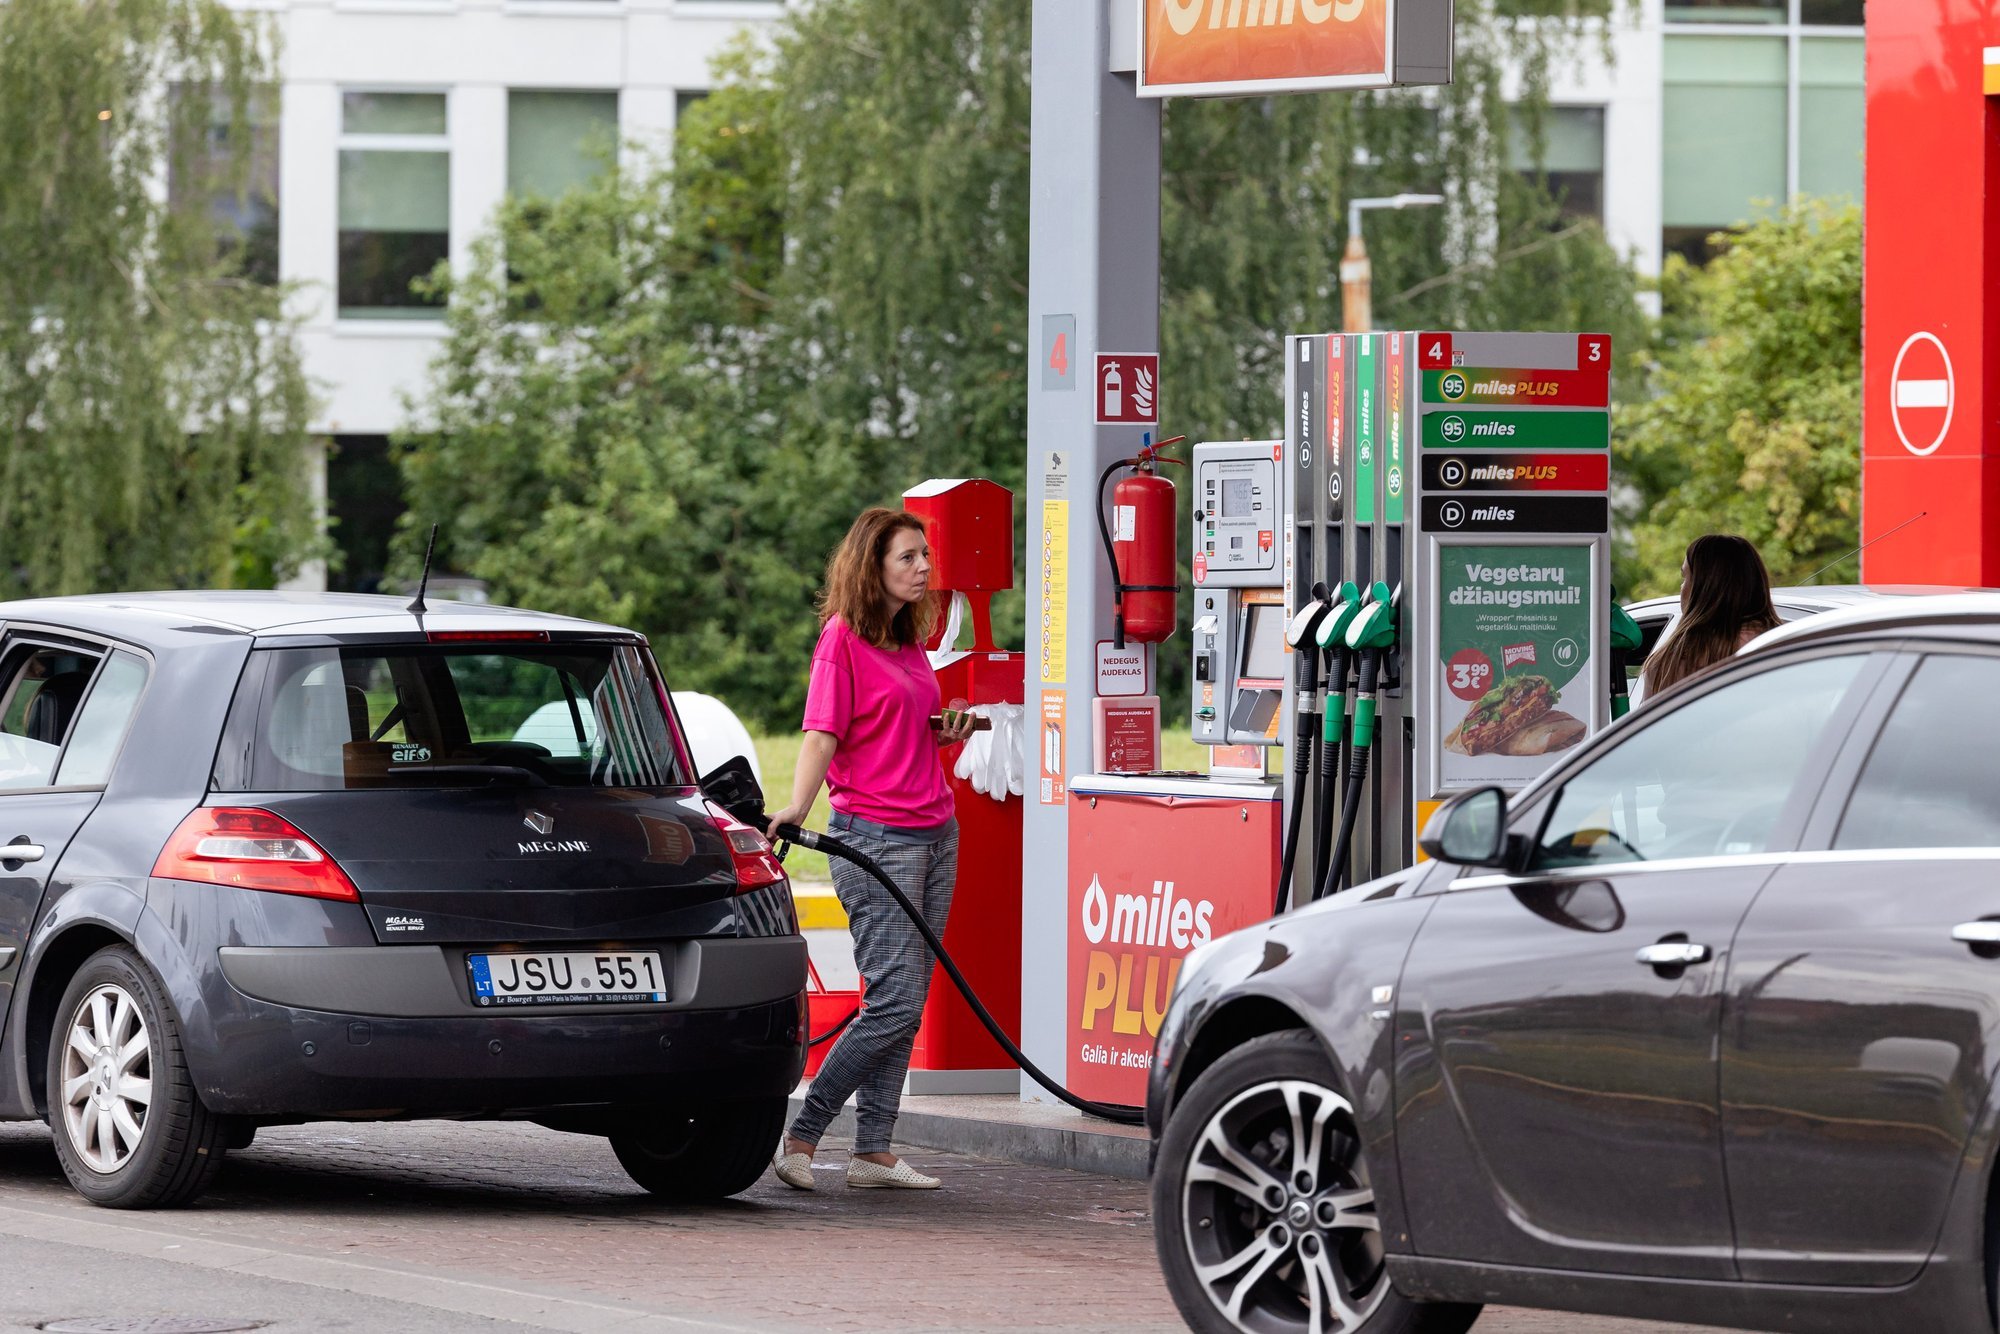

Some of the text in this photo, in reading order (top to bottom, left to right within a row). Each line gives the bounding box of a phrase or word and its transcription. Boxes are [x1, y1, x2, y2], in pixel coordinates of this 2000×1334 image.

[1050, 333, 1068, 376] 4
[1428, 342, 1443, 360] 4
[1588, 343, 1601, 361] 3
[1444, 380, 1463, 393] 95
[1301, 391, 1309, 437] miles
[1361, 389, 1370, 435] miles
[1444, 422, 1515, 436] 95 miles
[1446, 467, 1460, 480] D
[1446, 506, 1515, 521] D miles
[1465, 564, 1564, 585] Vegetarų
[1449, 586, 1581, 608] džiaugsmui!
[1476, 623, 1518, 632] vegetarišku
[1504, 645, 1534, 655] MOVING
[1103, 657, 1139, 665] NEDEGUS
[1101, 669, 1142, 677] AUDEKLAS
[392, 749, 416, 761] elf
[517, 841, 592, 855] MEGANE
[1110, 880, 1215, 949] miles
[498, 956, 656, 991] JSU 551
[476, 981, 490, 991] LT
[497, 996, 505, 1004] Le
[507, 996, 532, 1004] Bourget
[1081, 1044, 1107, 1064] Galia
[1110, 1046, 1118, 1065] ir
